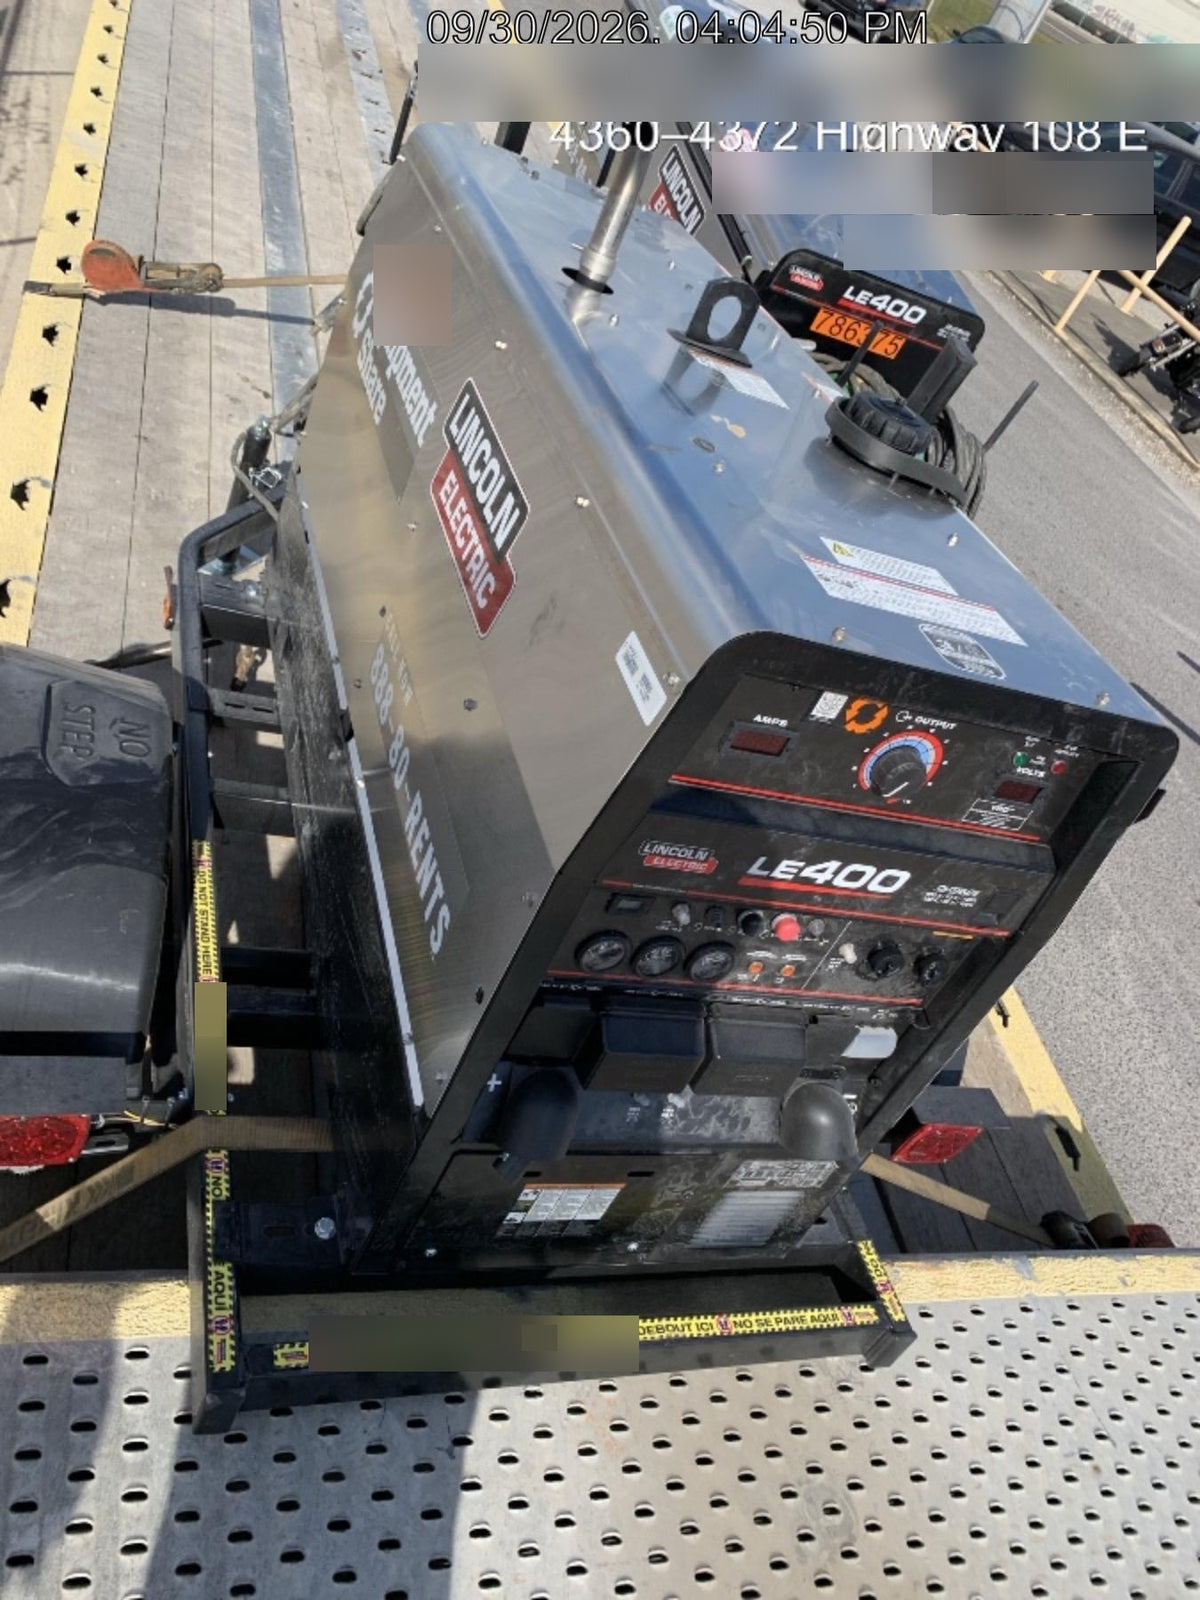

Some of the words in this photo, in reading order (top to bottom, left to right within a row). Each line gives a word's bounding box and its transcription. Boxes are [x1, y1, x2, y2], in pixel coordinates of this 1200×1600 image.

[661, 150, 702, 234] LINCOLN
[842, 286, 927, 325] LE400
[449, 393, 520, 550] LINCOLN
[439, 469, 496, 609] ELECTRIC
[60, 704, 96, 759] STEP
[753, 714, 788, 727] AMPS
[915, 715, 957, 730] OUTPUT
[118, 717, 151, 758] NO
[643, 842, 709, 861] LINCOLN
[652, 857, 708, 871] ELECTRIC
[197, 871, 207, 884] DO
[746, 856, 912, 894] LE400
[198, 886, 208, 906] NOT
[200, 910, 211, 943] STAND
[202, 947, 213, 976] HERE
[211, 1176, 223, 1198] NO
[694, 1321, 714, 1333] ICI
[733, 1319, 753, 1329] NO
[756, 1317, 773, 1328] SE
[775, 1314, 806, 1326] PARE
